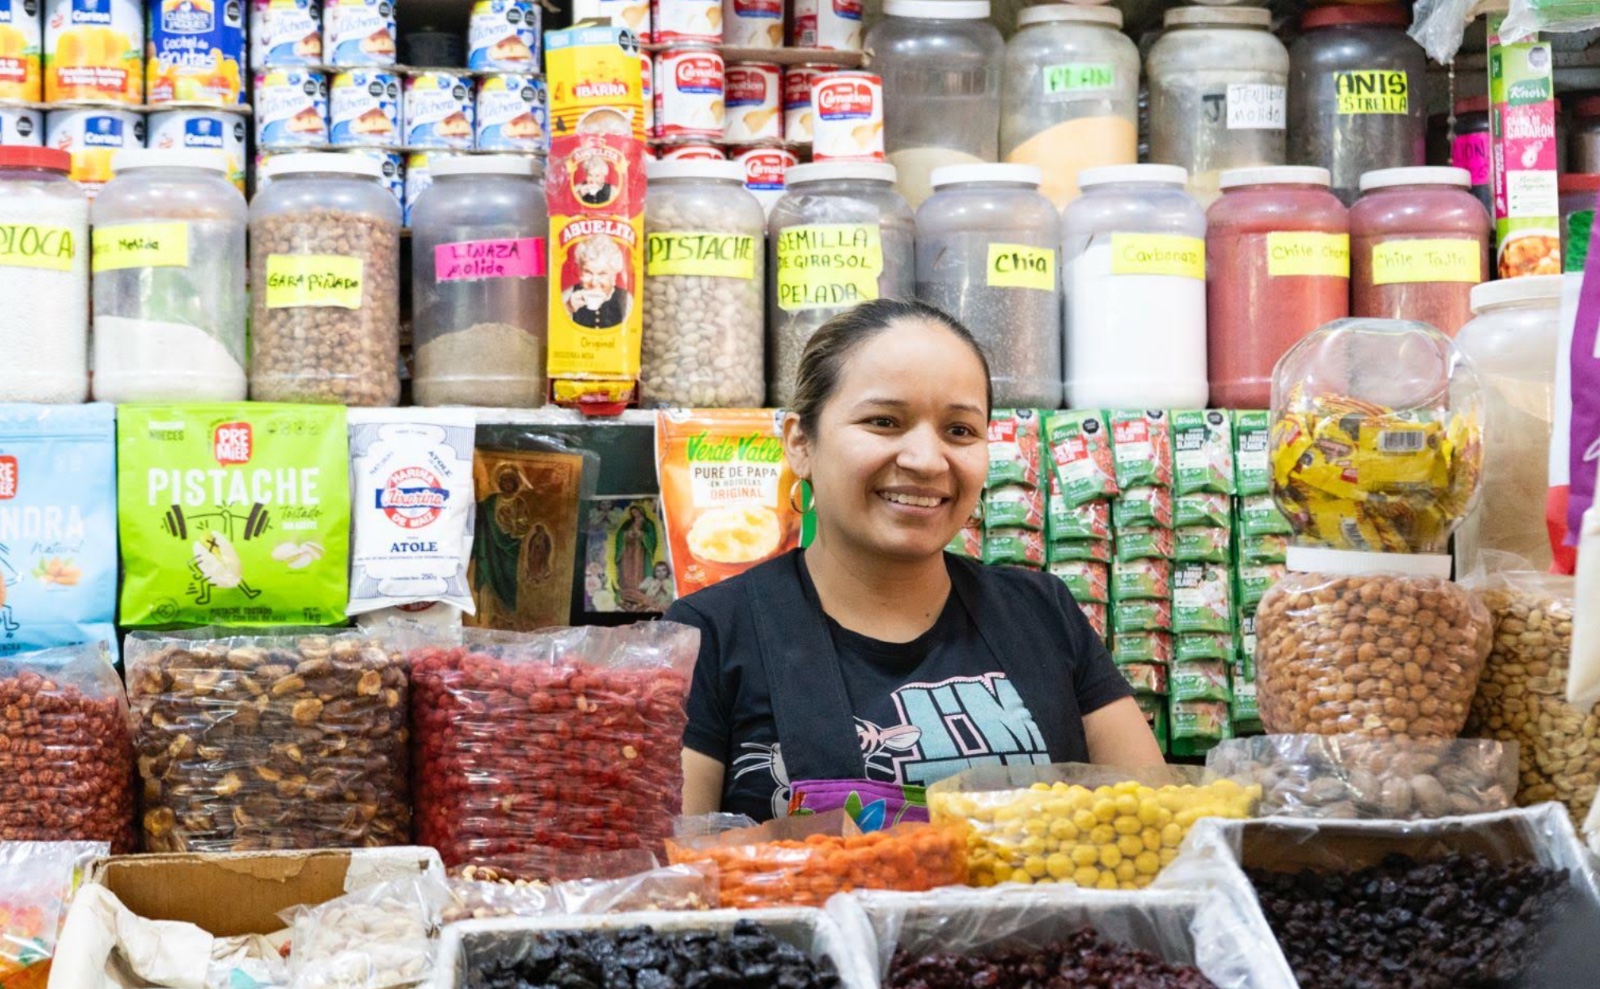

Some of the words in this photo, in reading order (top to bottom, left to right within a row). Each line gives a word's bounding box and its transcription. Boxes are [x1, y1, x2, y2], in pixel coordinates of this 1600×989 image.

[574, 83, 627, 96] IBARRA
[1335, 73, 1406, 95] ANIS
[1510, 85, 1547, 99] Knorr
[819, 83, 872, 108] Carnation
[563, 220, 636, 246] ABUELITA
[779, 228, 867, 252] SEMILLA
[451, 241, 520, 260] LINAZA
[649, 235, 752, 263] PISTACHE
[793, 254, 873, 269] GIRASOL
[995, 252, 1047, 274] Chia
[780, 283, 859, 304] PELADA
[580, 337, 617, 352] Original
[218, 428, 249, 446] PRE
[686, 430, 734, 462] Verde
[737, 431, 784, 463] Valle
[694, 466, 725, 479] PURÉ
[729, 467, 744, 478] DE
[747, 466, 778, 478] PAPA
[148, 466, 321, 506] PISTACHE
[710, 487, 765, 500] ORIGINAL
[390, 541, 438, 552] ATOLE
